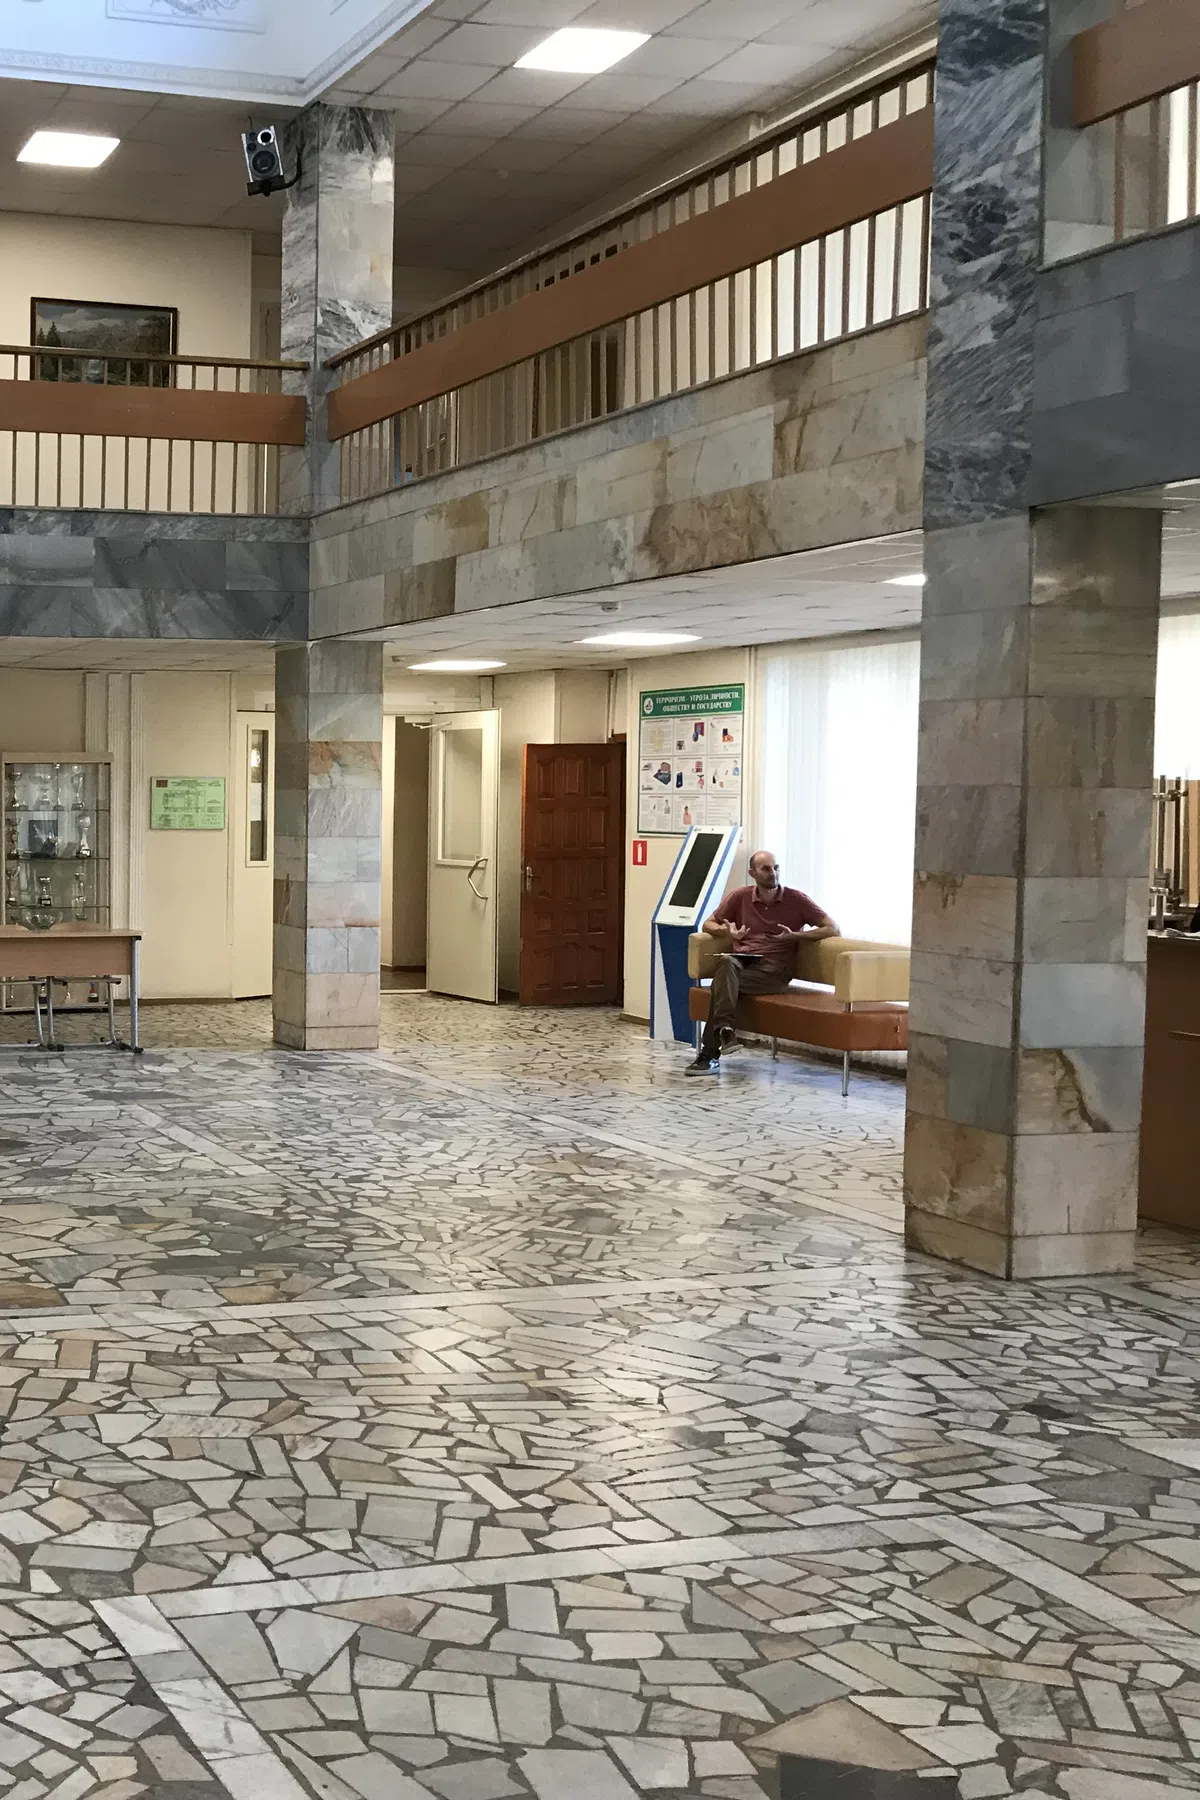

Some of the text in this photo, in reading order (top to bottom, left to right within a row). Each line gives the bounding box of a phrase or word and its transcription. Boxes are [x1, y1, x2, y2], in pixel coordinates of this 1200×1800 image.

[689, 693, 709, 702] УГРОЗА
[663, 704, 690, 712] ОБЩЕСТВУ
[697, 701, 732, 710] ГОСУДАРСТВУ
